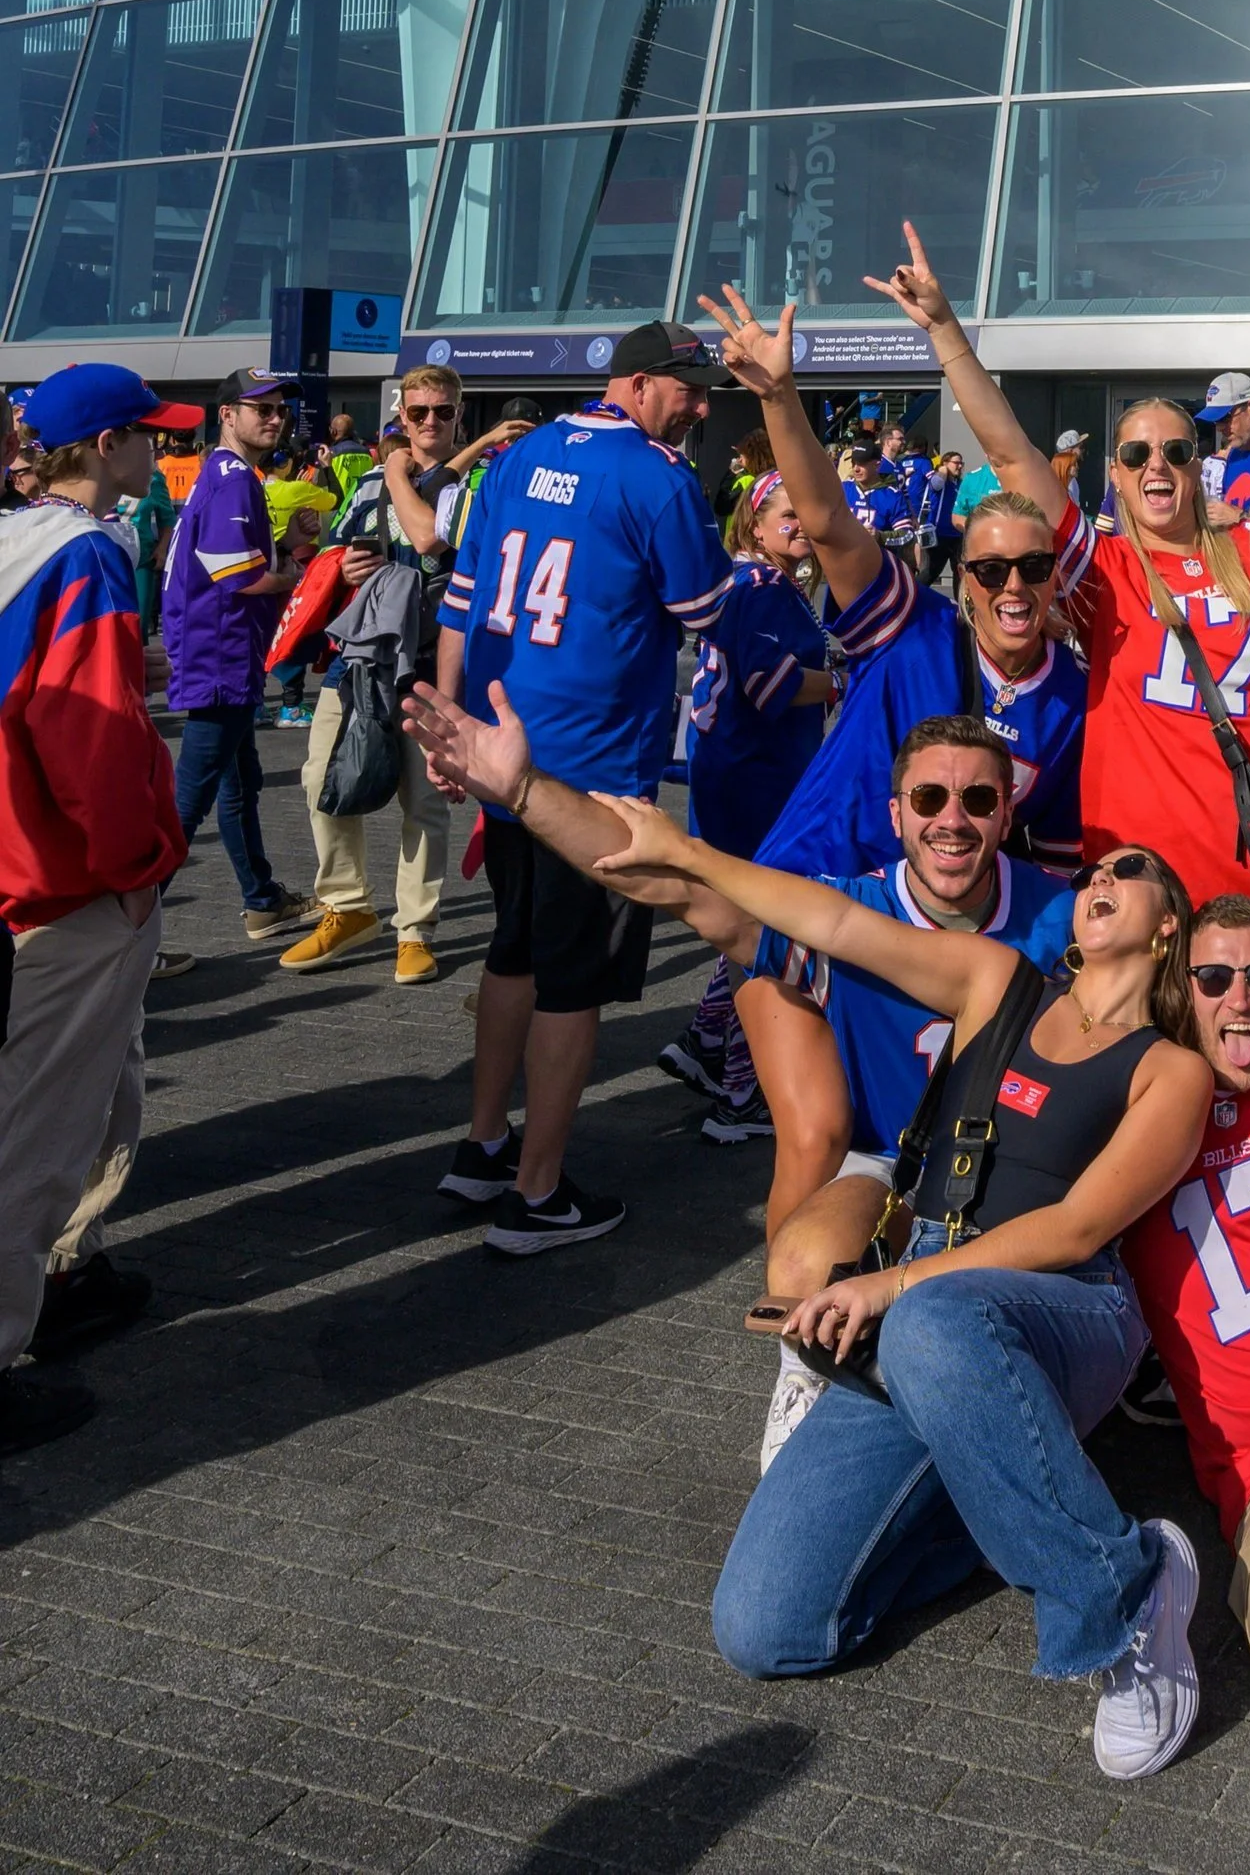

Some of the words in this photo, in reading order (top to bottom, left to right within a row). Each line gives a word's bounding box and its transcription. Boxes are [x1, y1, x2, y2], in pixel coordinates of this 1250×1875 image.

[491, 350, 506, 358] digital
[520, 350, 534, 358] ready
[390, 389, 401, 411] 2
[218, 459, 248, 476] 14
[526, 467, 580, 506] DIGGS
[750, 566, 783, 587] 17
[486, 528, 575, 647] 14
